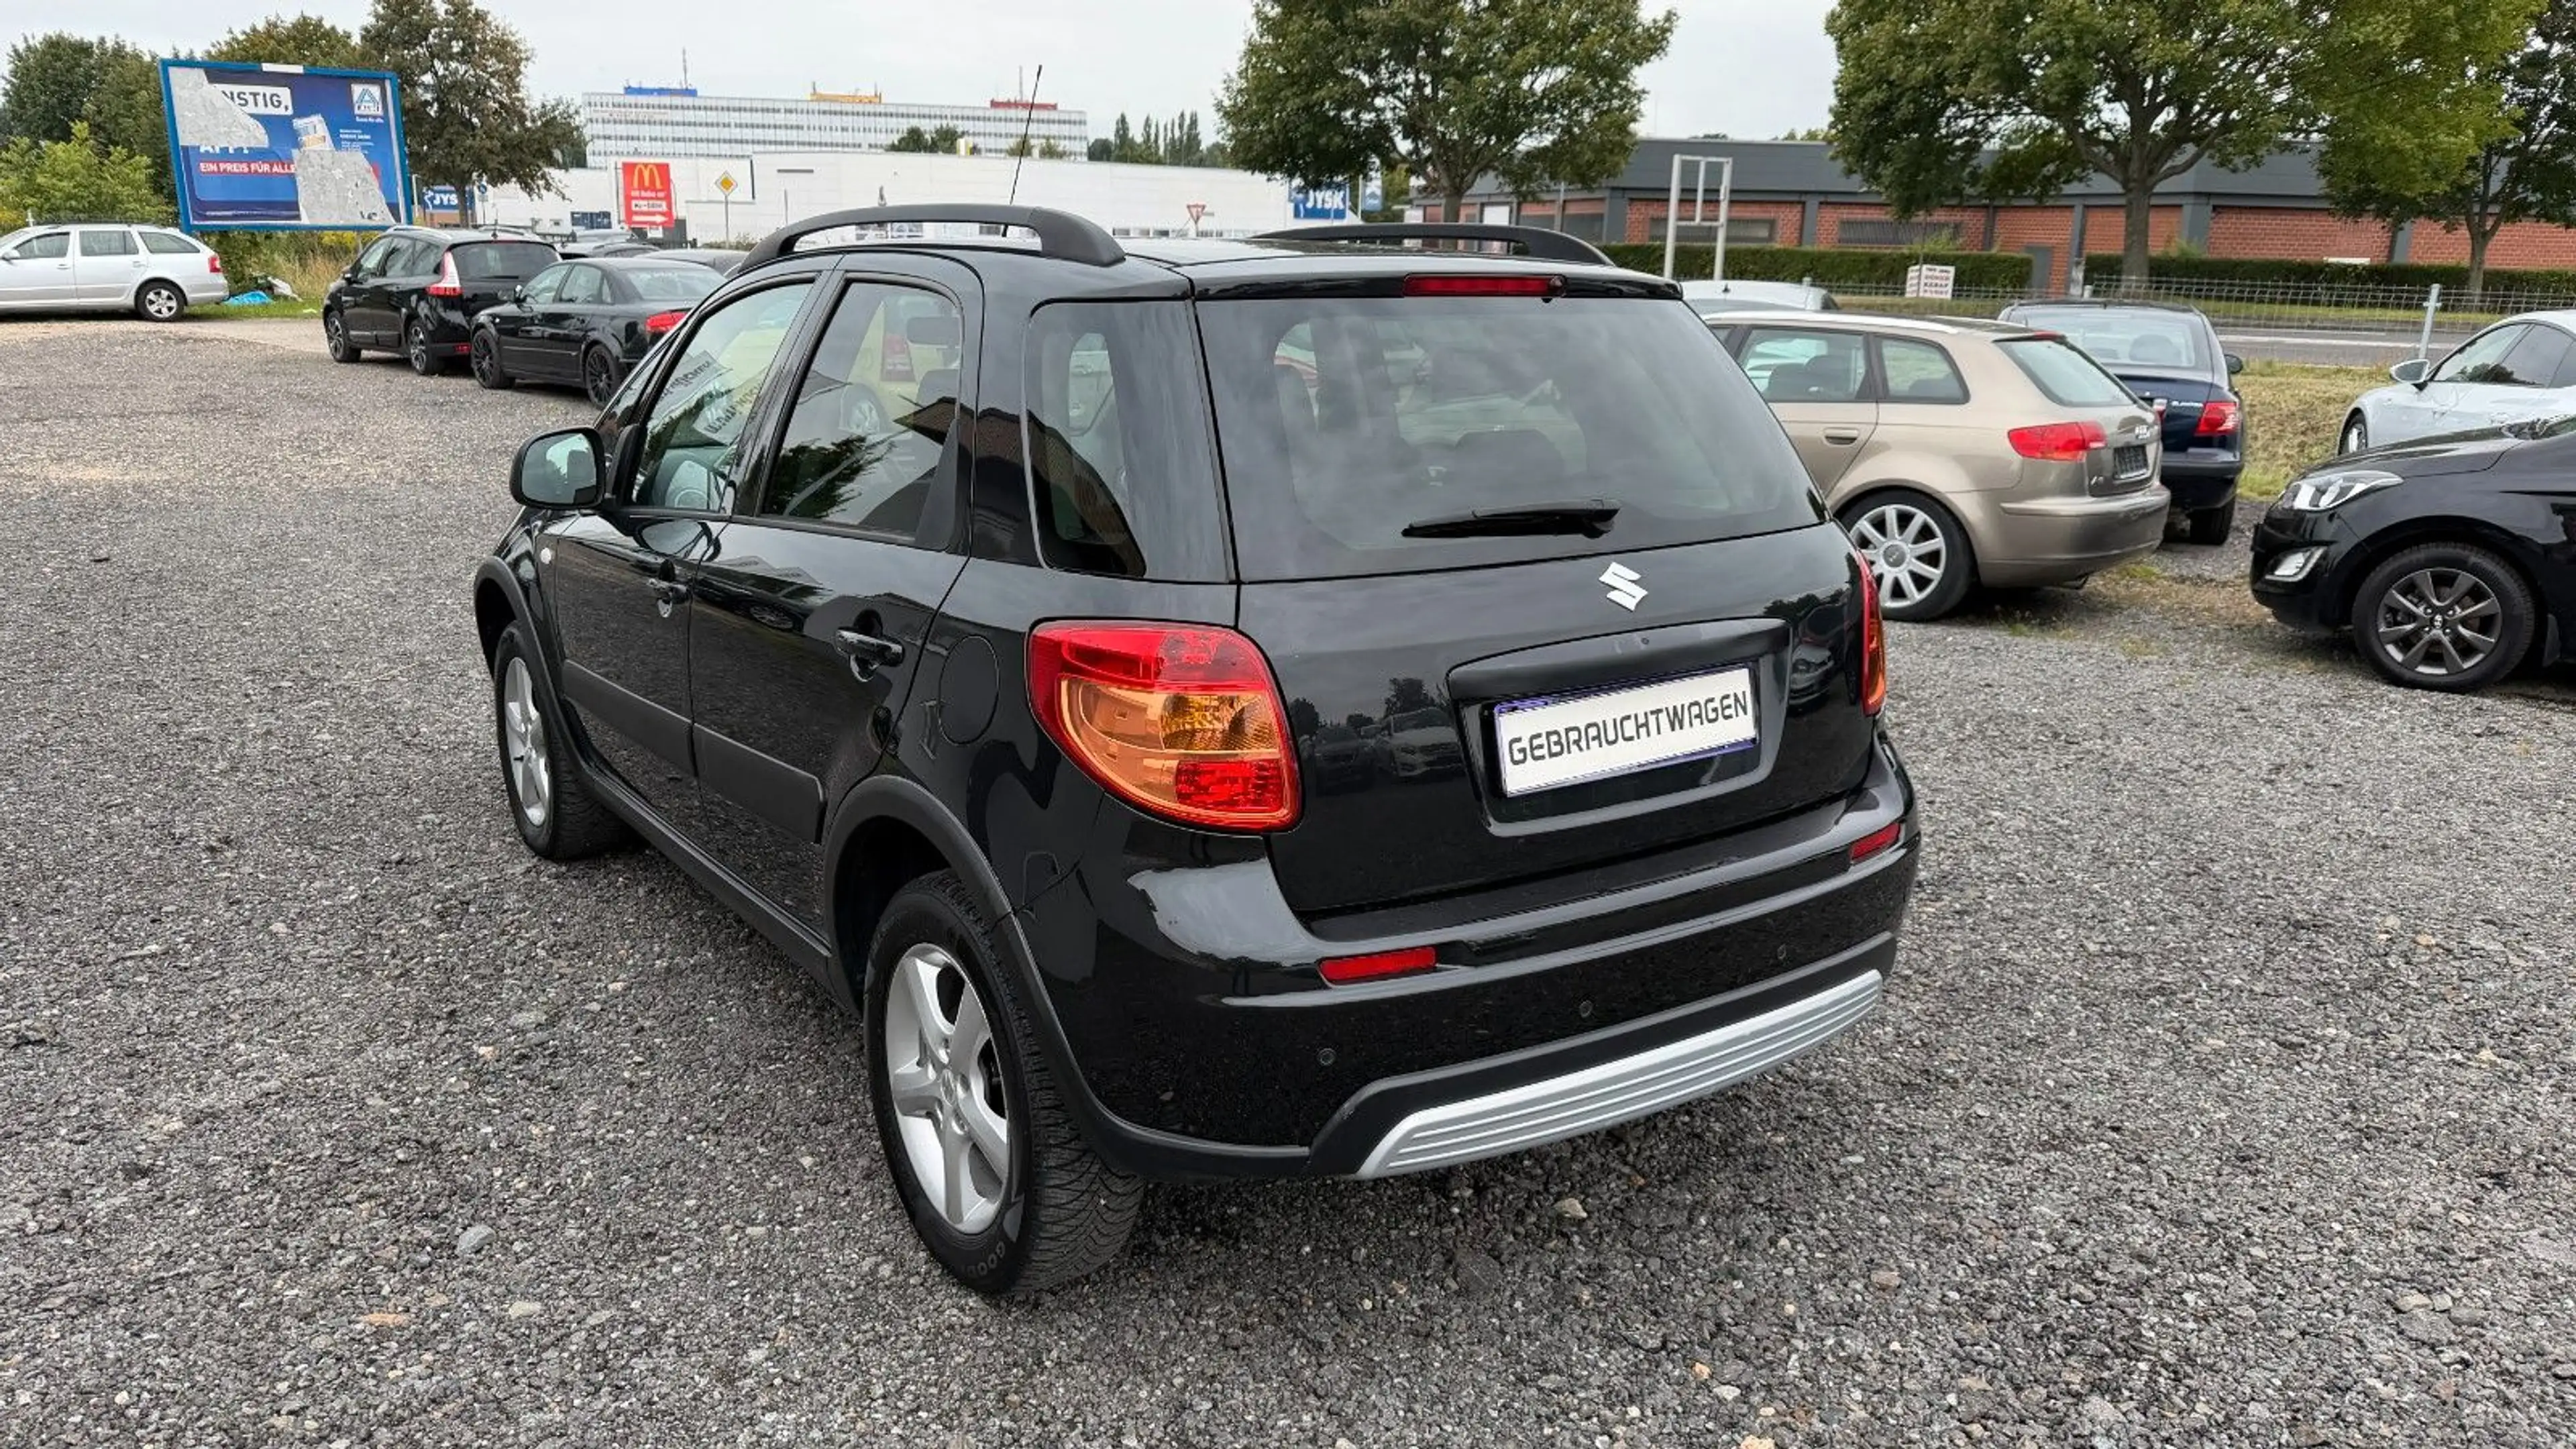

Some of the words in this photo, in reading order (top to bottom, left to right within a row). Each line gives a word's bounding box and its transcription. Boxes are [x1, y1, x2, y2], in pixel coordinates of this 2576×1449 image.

[200, 162, 217, 172] EIN
[219, 162, 248, 173] PREIS
[251, 161, 270, 173] FÜR
[433, 193, 469, 205] JYS
[1305, 189, 1345, 209] JYSK
[1508, 691, 1748, 765] GEBRAUCHTWAGEN
